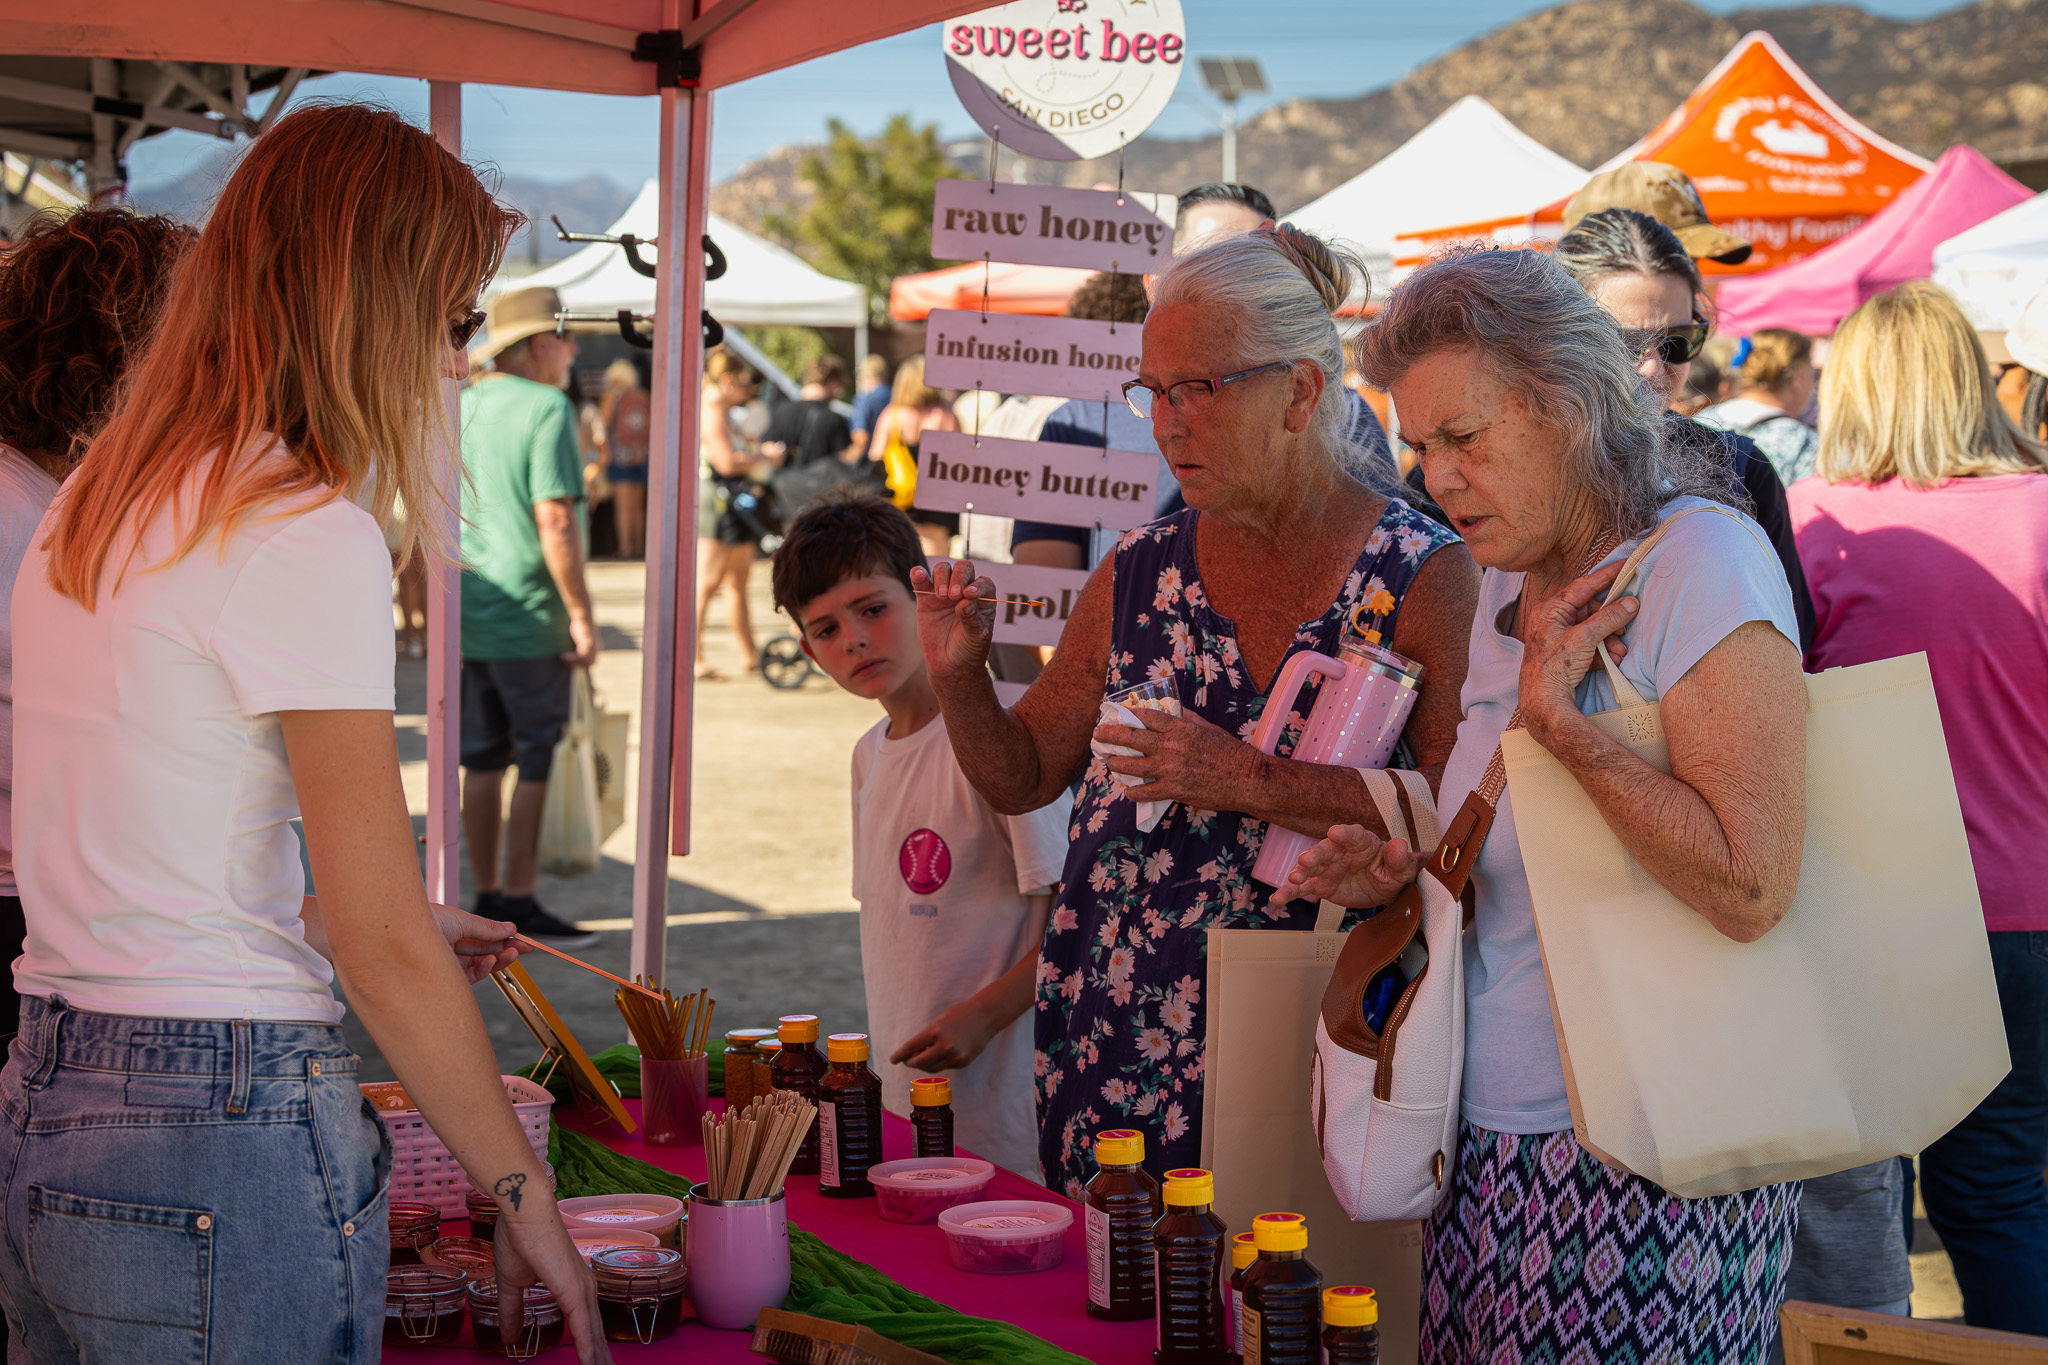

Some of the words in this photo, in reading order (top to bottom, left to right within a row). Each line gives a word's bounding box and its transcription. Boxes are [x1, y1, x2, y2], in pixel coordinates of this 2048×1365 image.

[950, 23, 1090, 60] sweet
[1100, 18, 1183, 64] bee
[996, 87, 1042, 122] SAN
[1049, 93, 1124, 128] DIEGO
[943, 207, 1027, 236] raw
[1038, 205, 1166, 255] honey
[936, 332, 1059, 365] infusion
[1067, 344, 1140, 372] hone
[927, 453, 1031, 497] honey
[1040, 465, 1148, 502] butter
[1003, 588, 1081, 625] pol
